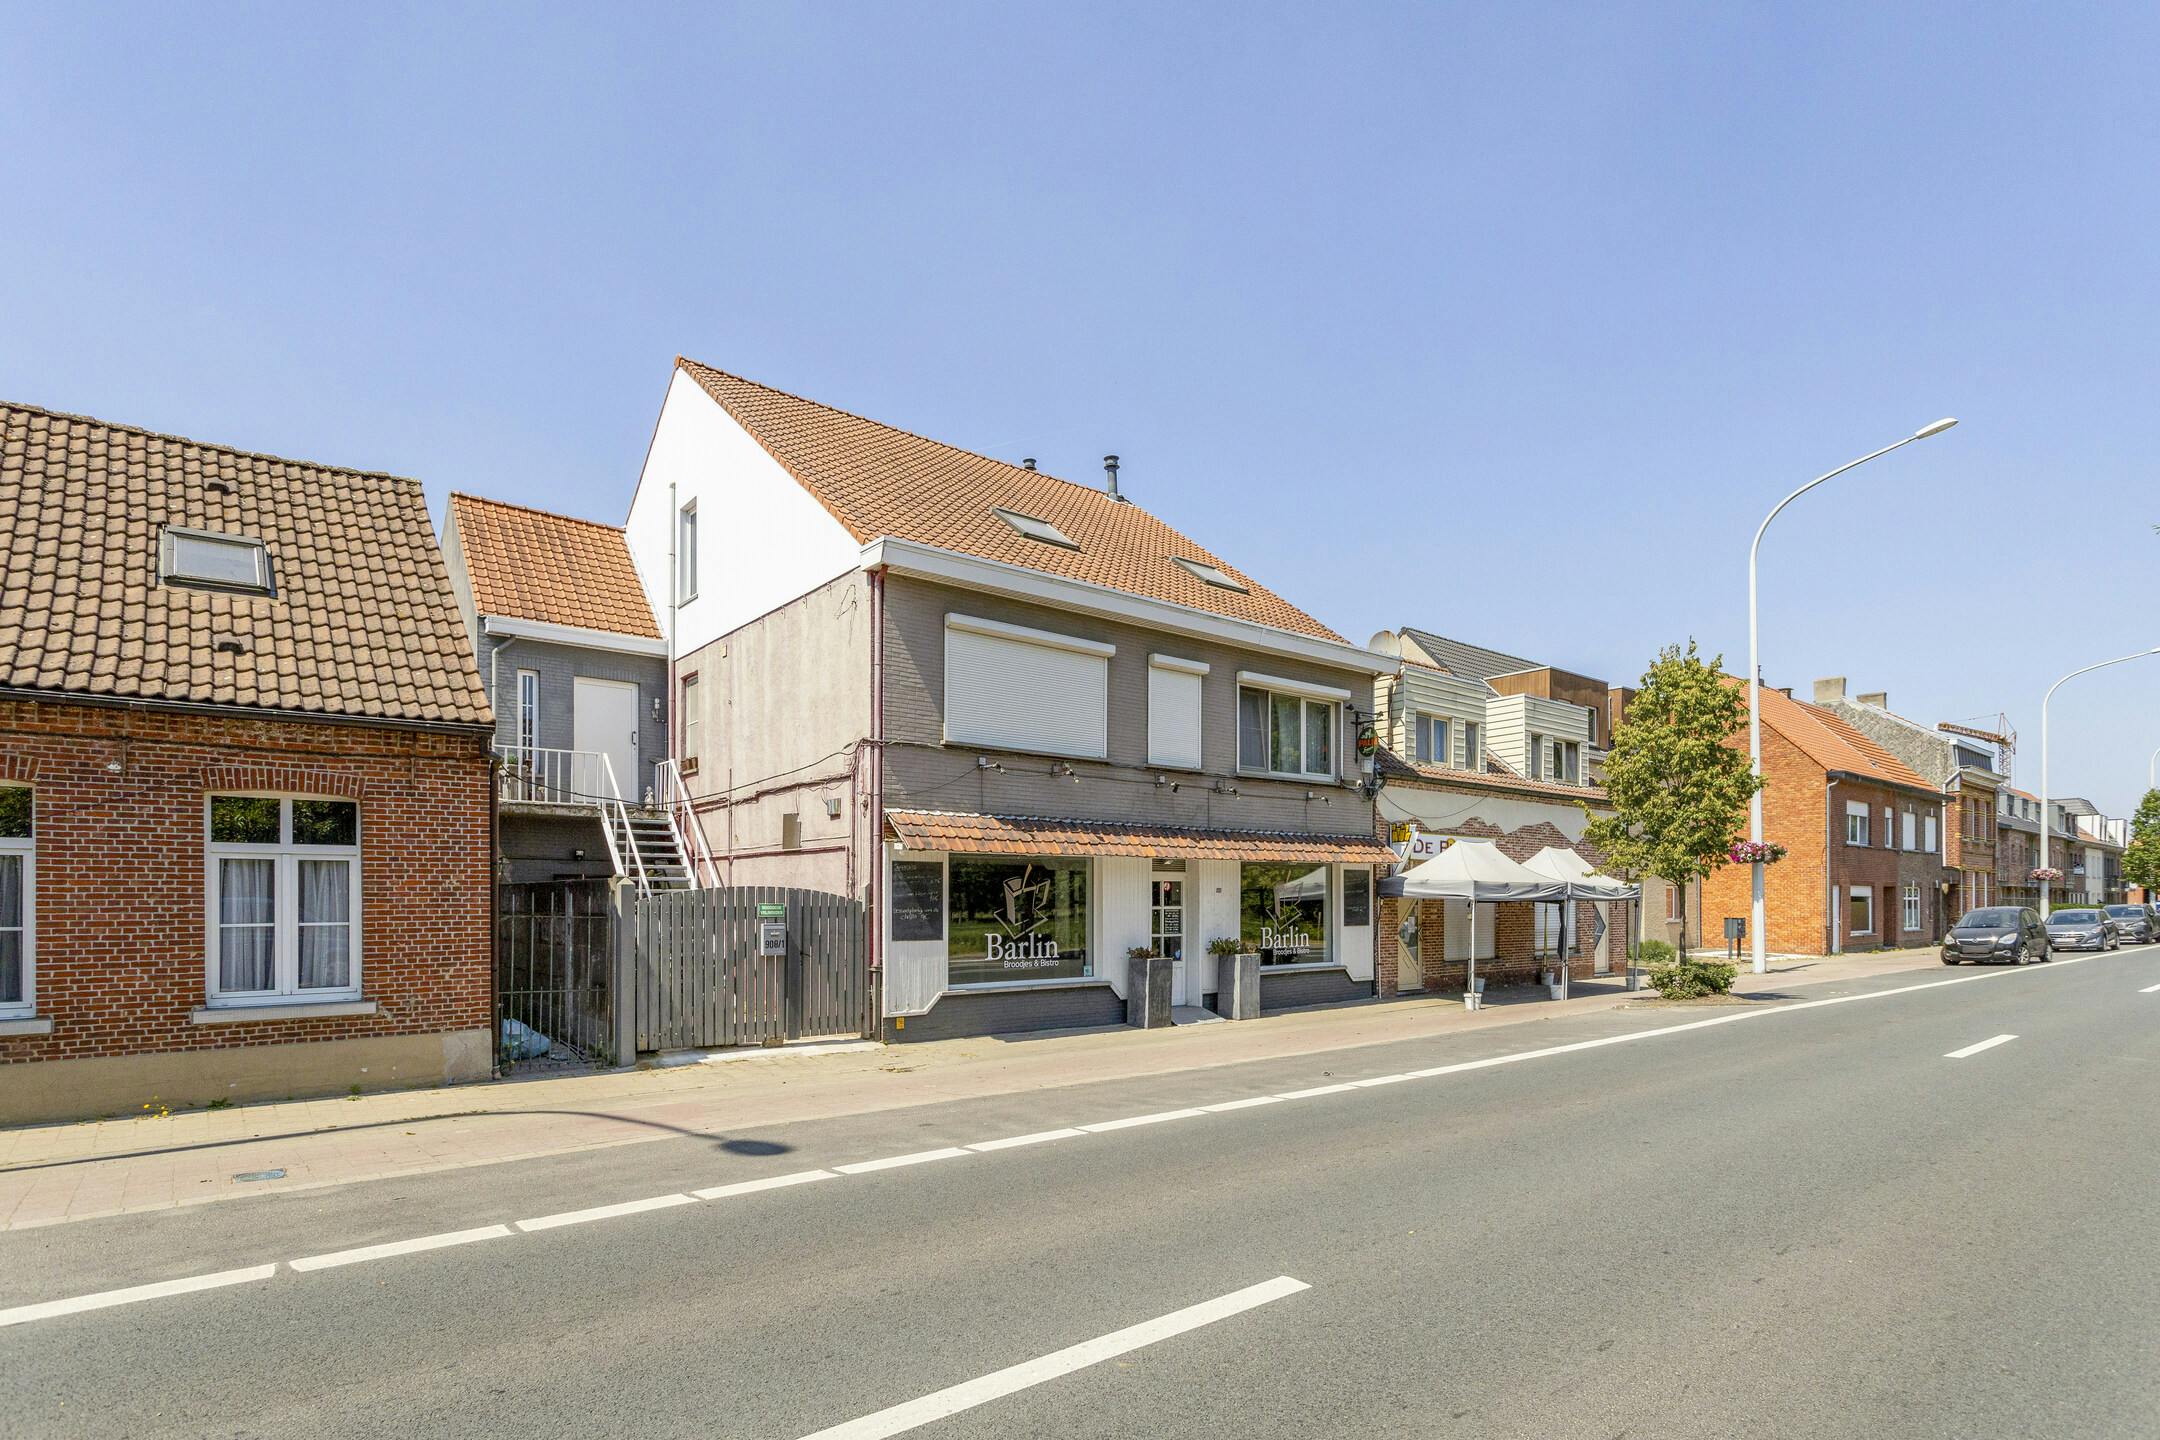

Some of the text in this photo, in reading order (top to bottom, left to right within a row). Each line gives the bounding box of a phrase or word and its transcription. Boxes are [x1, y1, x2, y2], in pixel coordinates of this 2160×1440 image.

[1413, 838, 1434, 854] DE
[764, 939, 785, 949] 908/1
[1260, 925, 1310, 950] Barlin
[984, 932, 1060, 961] Barlin
[1273, 948, 1292, 956] Broodjes
[1004, 959, 1060, 969] Broodjes & Bistro
